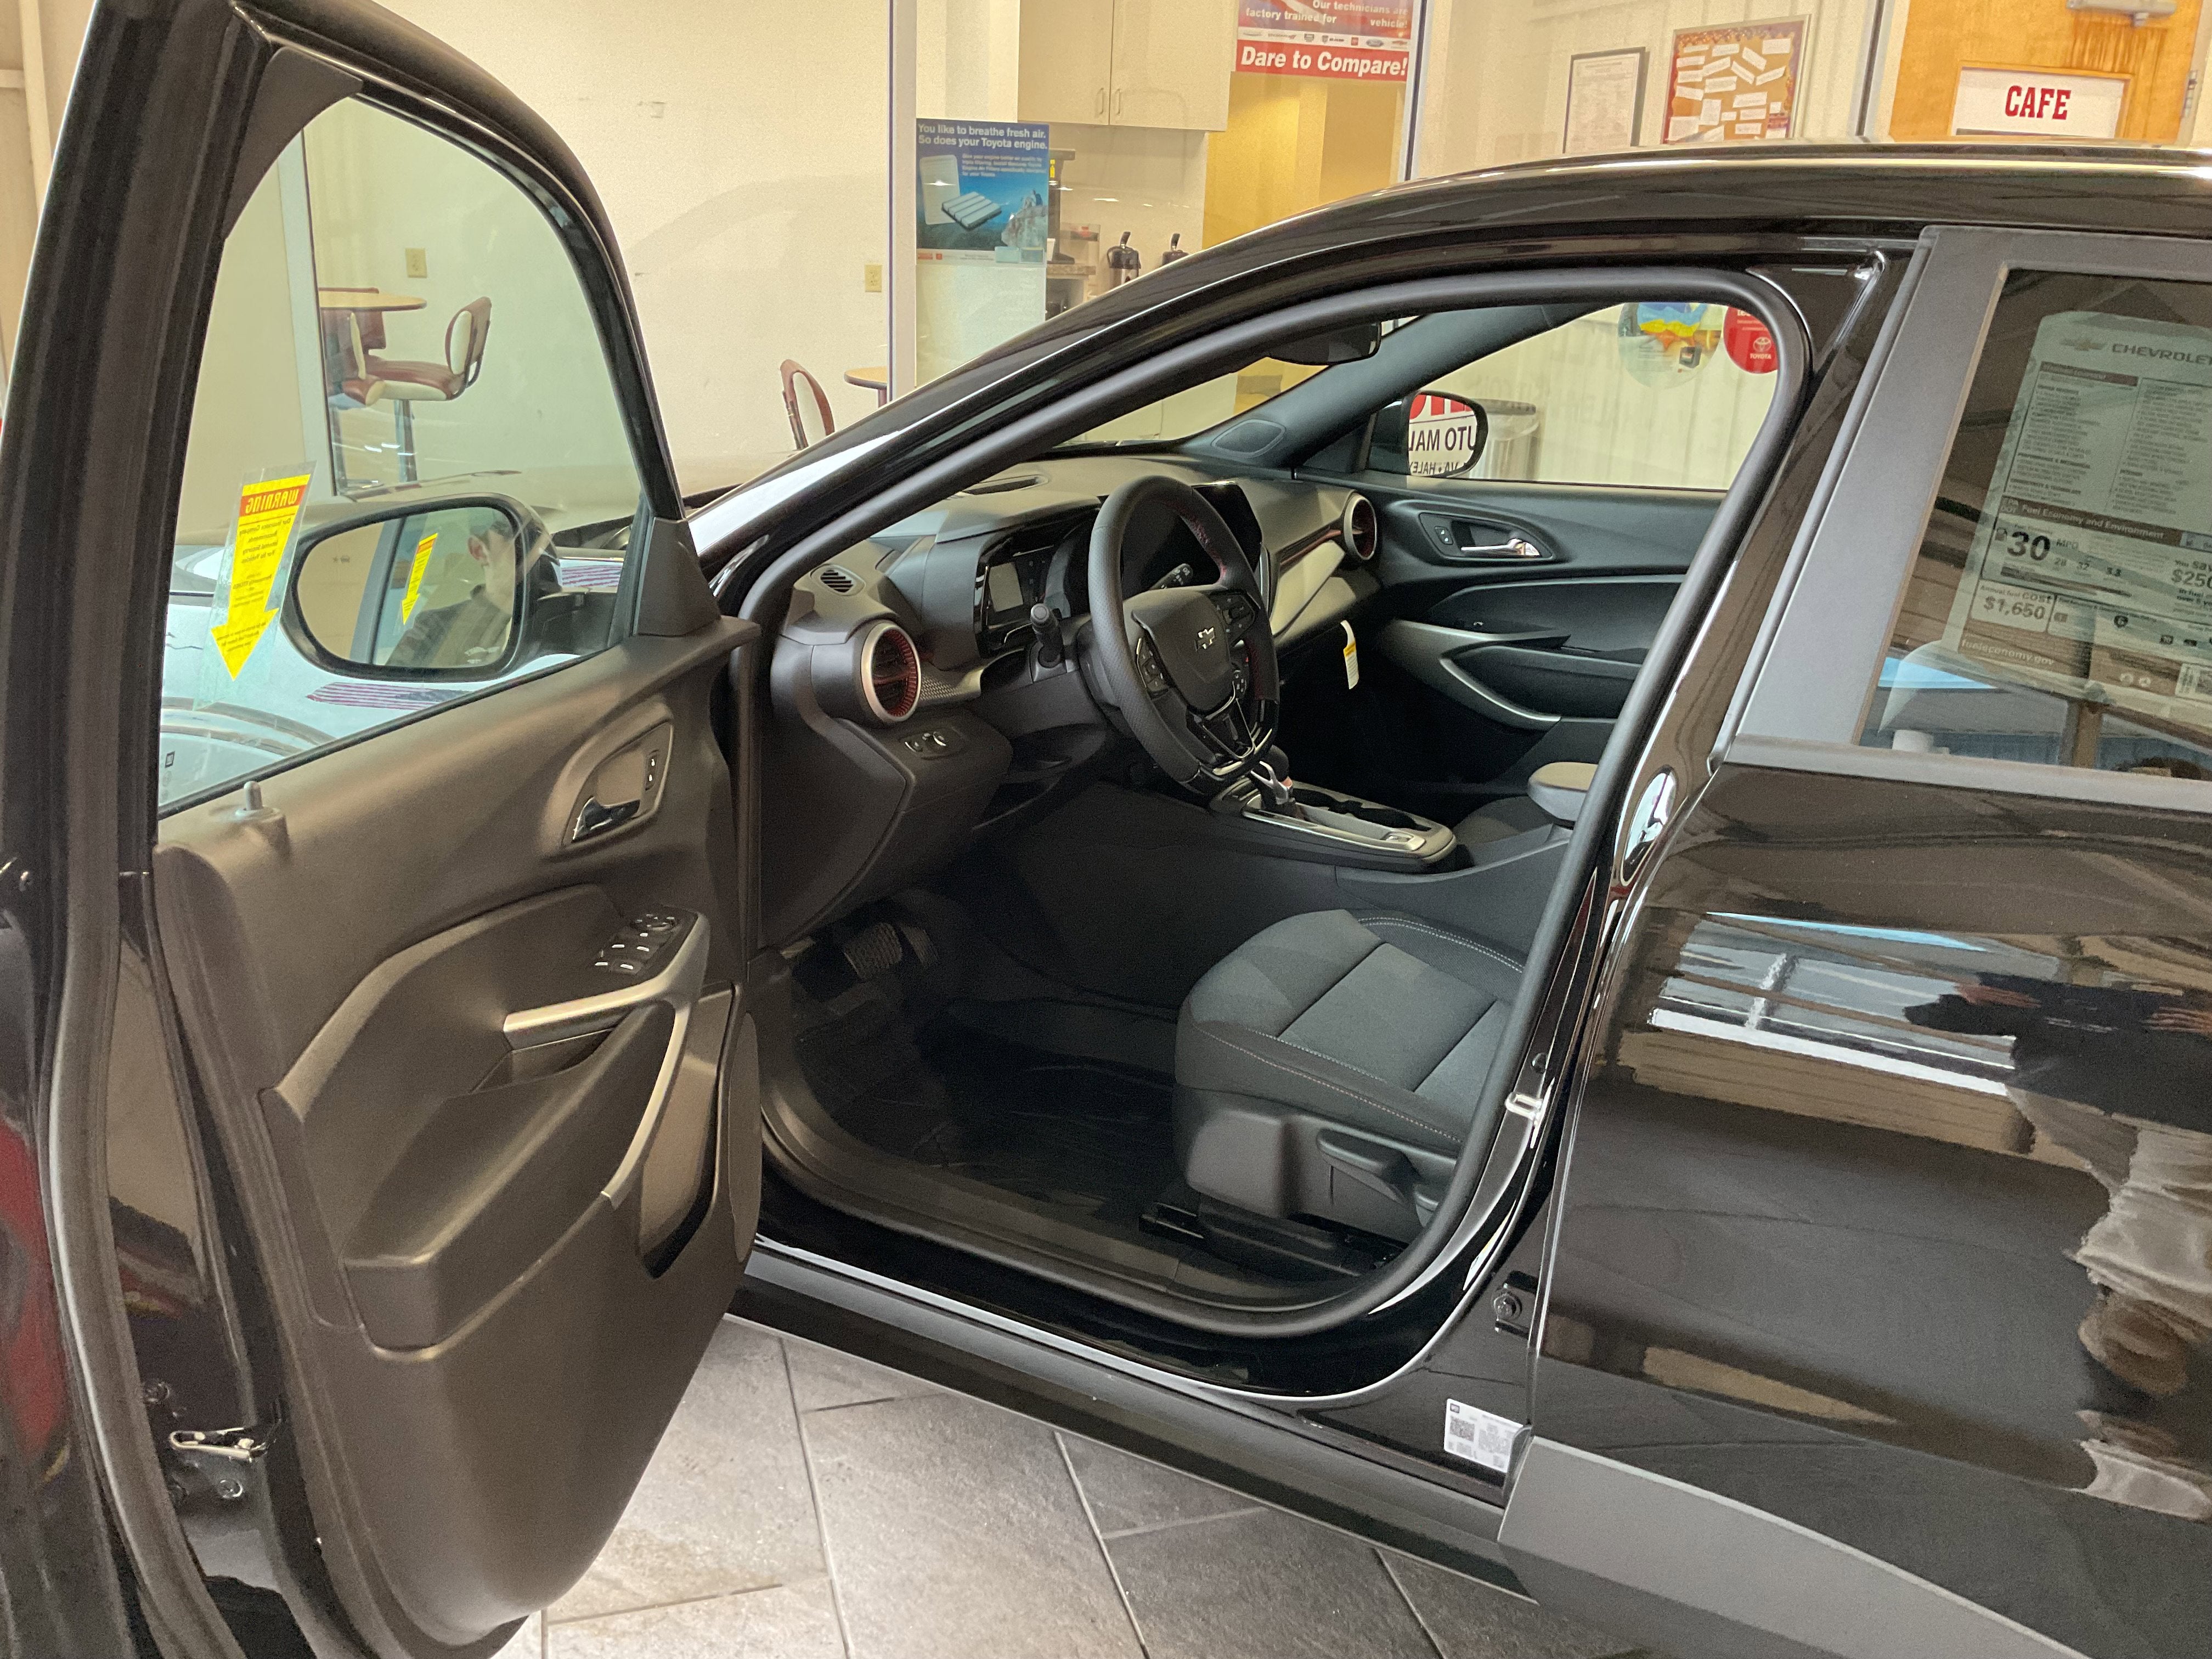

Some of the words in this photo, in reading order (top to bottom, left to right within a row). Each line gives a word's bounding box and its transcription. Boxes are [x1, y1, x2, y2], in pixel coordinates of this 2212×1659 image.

[1246, 8, 1281, 21] factory
[1284, 10, 1319, 22] trained
[1323, 13, 1337, 24] for
[1370, 18, 1408, 29] vehicle!
[1312, 0, 1329, 9] Our
[1334, 2, 1390, 14] technicians
[1393, 7, 1408, 15] are
[1241, 46, 1286, 67] Dare
[1293, 50, 1312, 70] to
[1317, 51, 1408, 77] Compare!
[2005, 85, 2072, 120] CAFE
[918, 123, 935, 133] You
[938, 125, 955, 134] like
[957, 126, 967, 135] to
[969, 126, 1005, 137] breathe
[1007, 127, 1030, 138] fresh
[1032, 129, 1046, 138] air.
[918, 134, 932, 144] So
[934, 136, 957, 145] does
[958, 138, 979, 148] your
[981, 137, 1012, 149] Toyota
[1014, 140, 1048, 150] engine.
[2007, 531, 2051, 561] 30
[1984, 596, 2046, 620] $1,650
